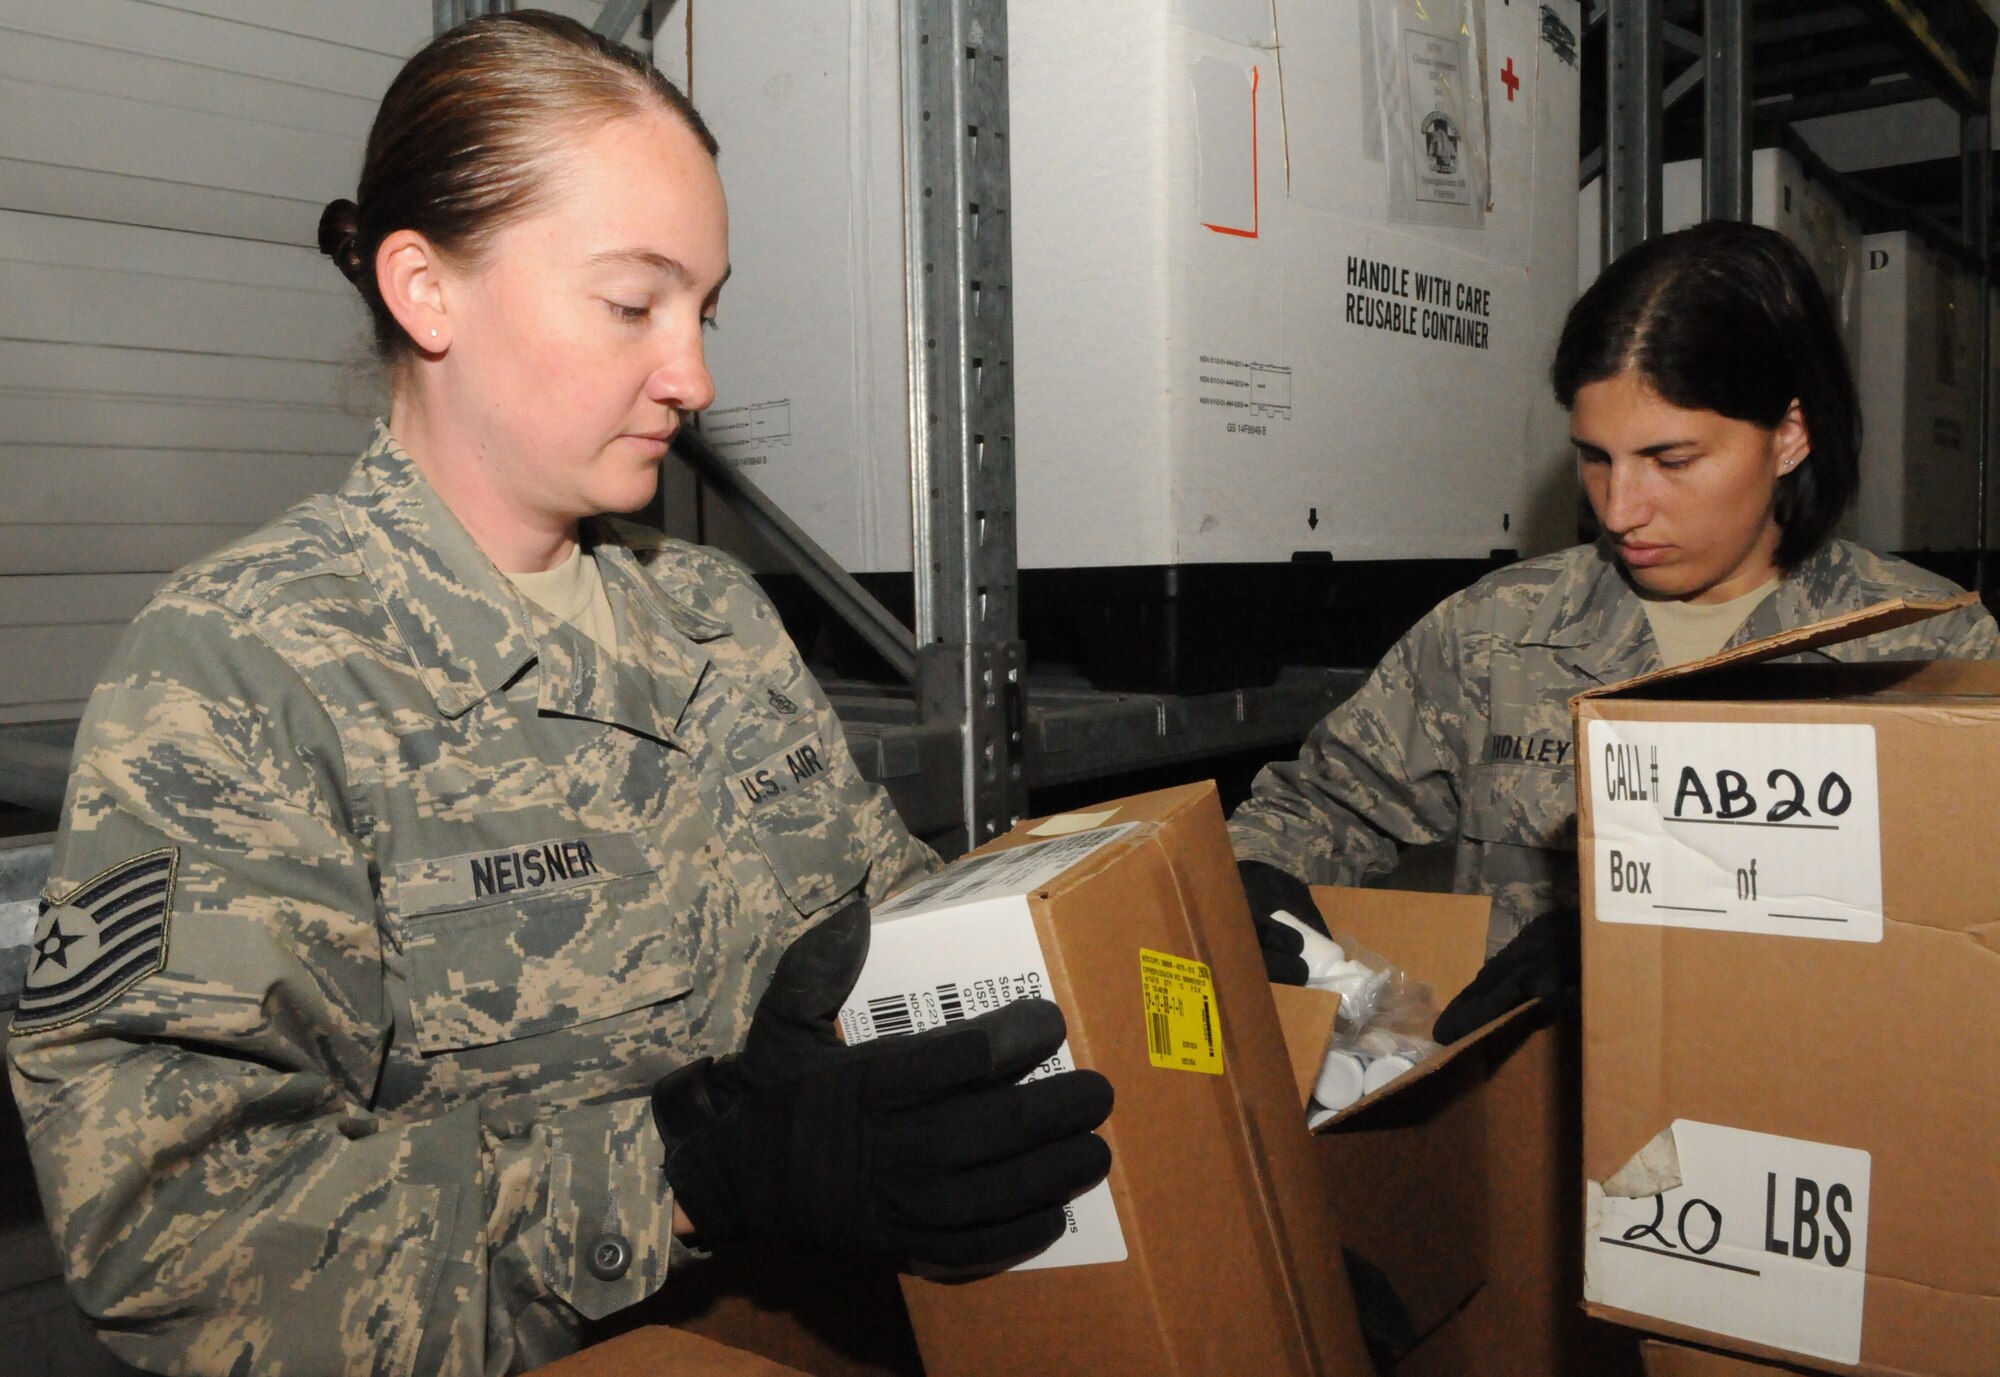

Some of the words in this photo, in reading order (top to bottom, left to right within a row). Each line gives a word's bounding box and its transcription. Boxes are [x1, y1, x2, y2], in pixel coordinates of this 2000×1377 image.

[1347, 256, 1409, 298] HANDLE
[1415, 272, 1451, 307] WITH
[1456, 282, 1490, 317] CARE
[1870, 250, 1888, 271] D
[1346, 292, 1417, 335] REUSABLE
[1422, 309, 1489, 349] CONTAINER
[739, 769, 788, 803] U.S.
[786, 745, 824, 785] AIR
[1673, 765, 1852, 822] AB20
[470, 840, 597, 899] NEISNER
[1610, 850, 1652, 894] Box
[1737, 859, 1758, 901] of
[909, 993, 922, 1018] NDC
[922, 992, 939, 1025] (22)
[963, 988, 976, 1012] QTY
[974, 981, 989, 1008] USP
[1064, 1206, 1078, 1233] ions
[1622, 1193, 1722, 1255] 20
[1765, 1171, 1852, 1267] LBS
